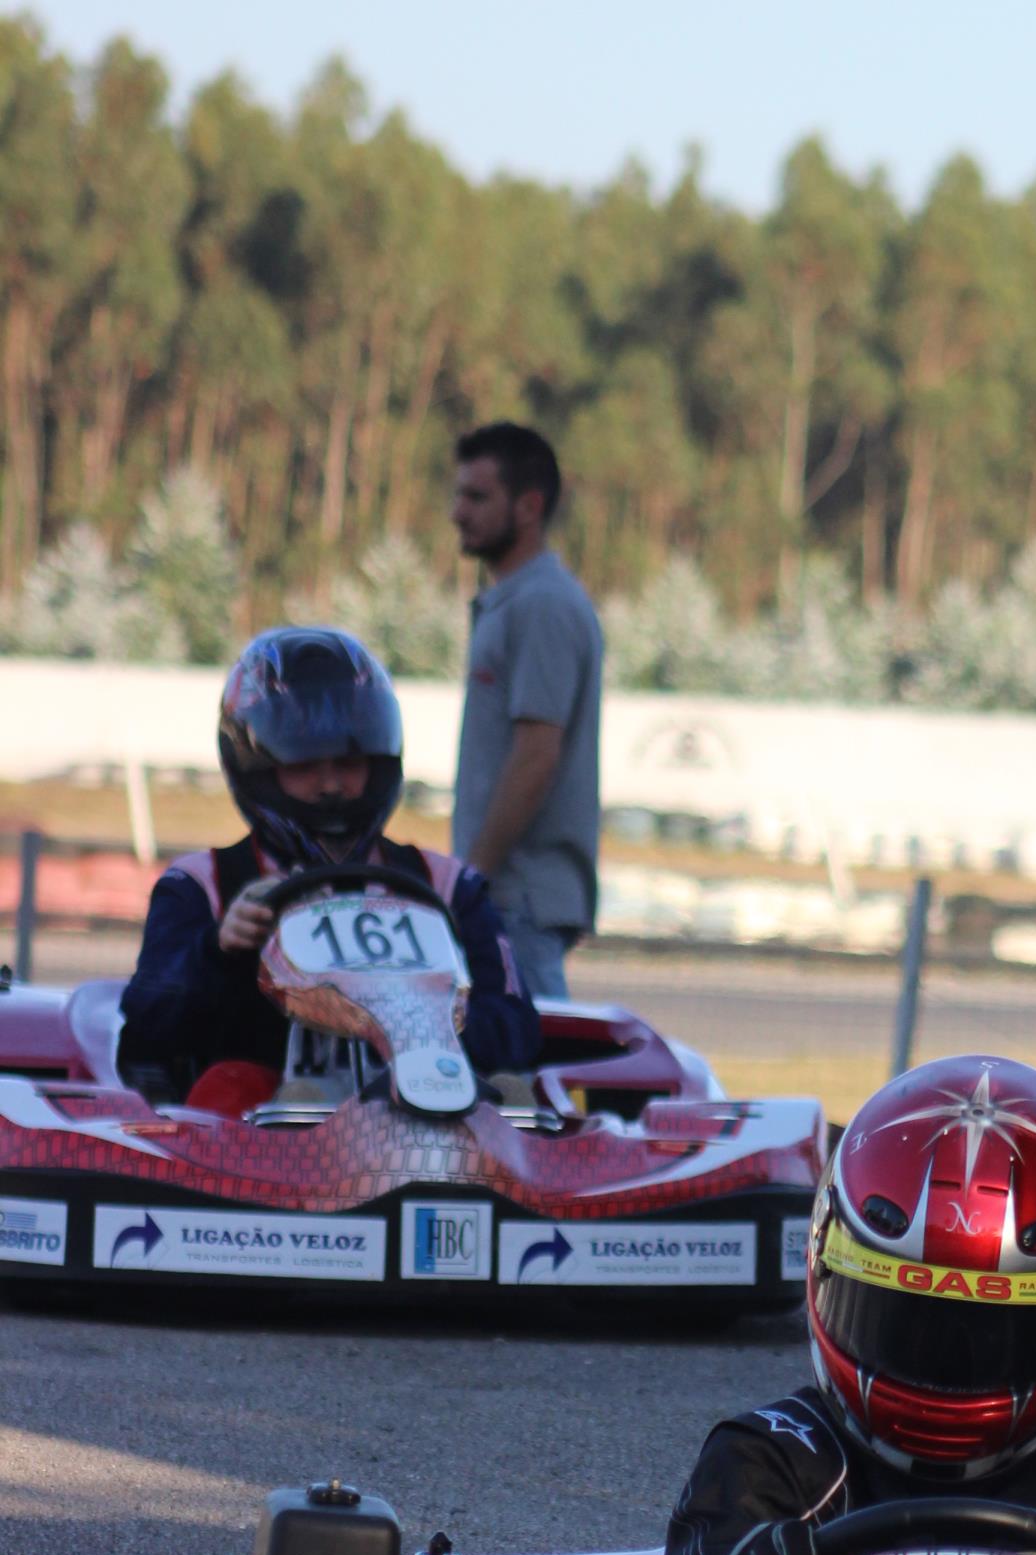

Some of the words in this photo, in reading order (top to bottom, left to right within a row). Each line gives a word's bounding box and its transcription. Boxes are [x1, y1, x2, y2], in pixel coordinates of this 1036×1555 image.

[311, 912, 428, 964] 161
[945, 1201, 980, 1235] N
[181, 1228, 284, 1251] LIGAÇÃO
[290, 1233, 367, 1251] VELOZ
[591, 1239, 681, 1261] LIGAÇÃO
[686, 1242, 743, 1257] VELOZ
[187, 1252, 283, 1266] TRANSPORTES
[861, 1259, 892, 1272] TEAM
[897, 1264, 1012, 1300] GAS
